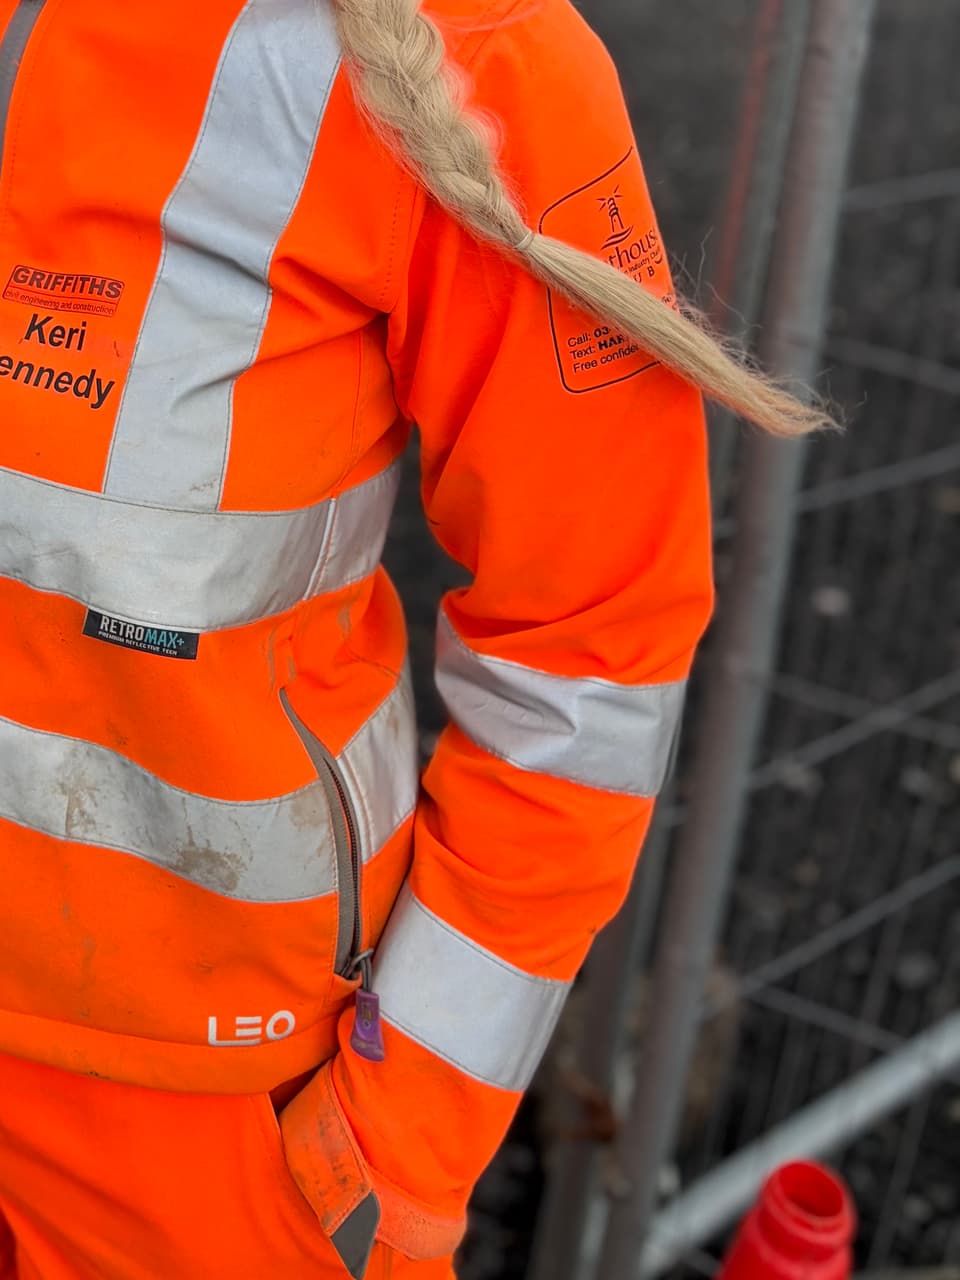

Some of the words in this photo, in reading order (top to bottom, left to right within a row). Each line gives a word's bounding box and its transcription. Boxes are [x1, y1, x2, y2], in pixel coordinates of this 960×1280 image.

[13, 268, 122, 298] GRIFFITHS
[20, 294, 60, 309] engineering
[72, 303, 114, 314] construction
[25, 313, 87, 351] Keri
[567, 332, 591, 347] Call:
[570, 346, 595, 359] Text:
[573, 360, 598, 373] Free
[208, 1010, 295, 1046] LEO
